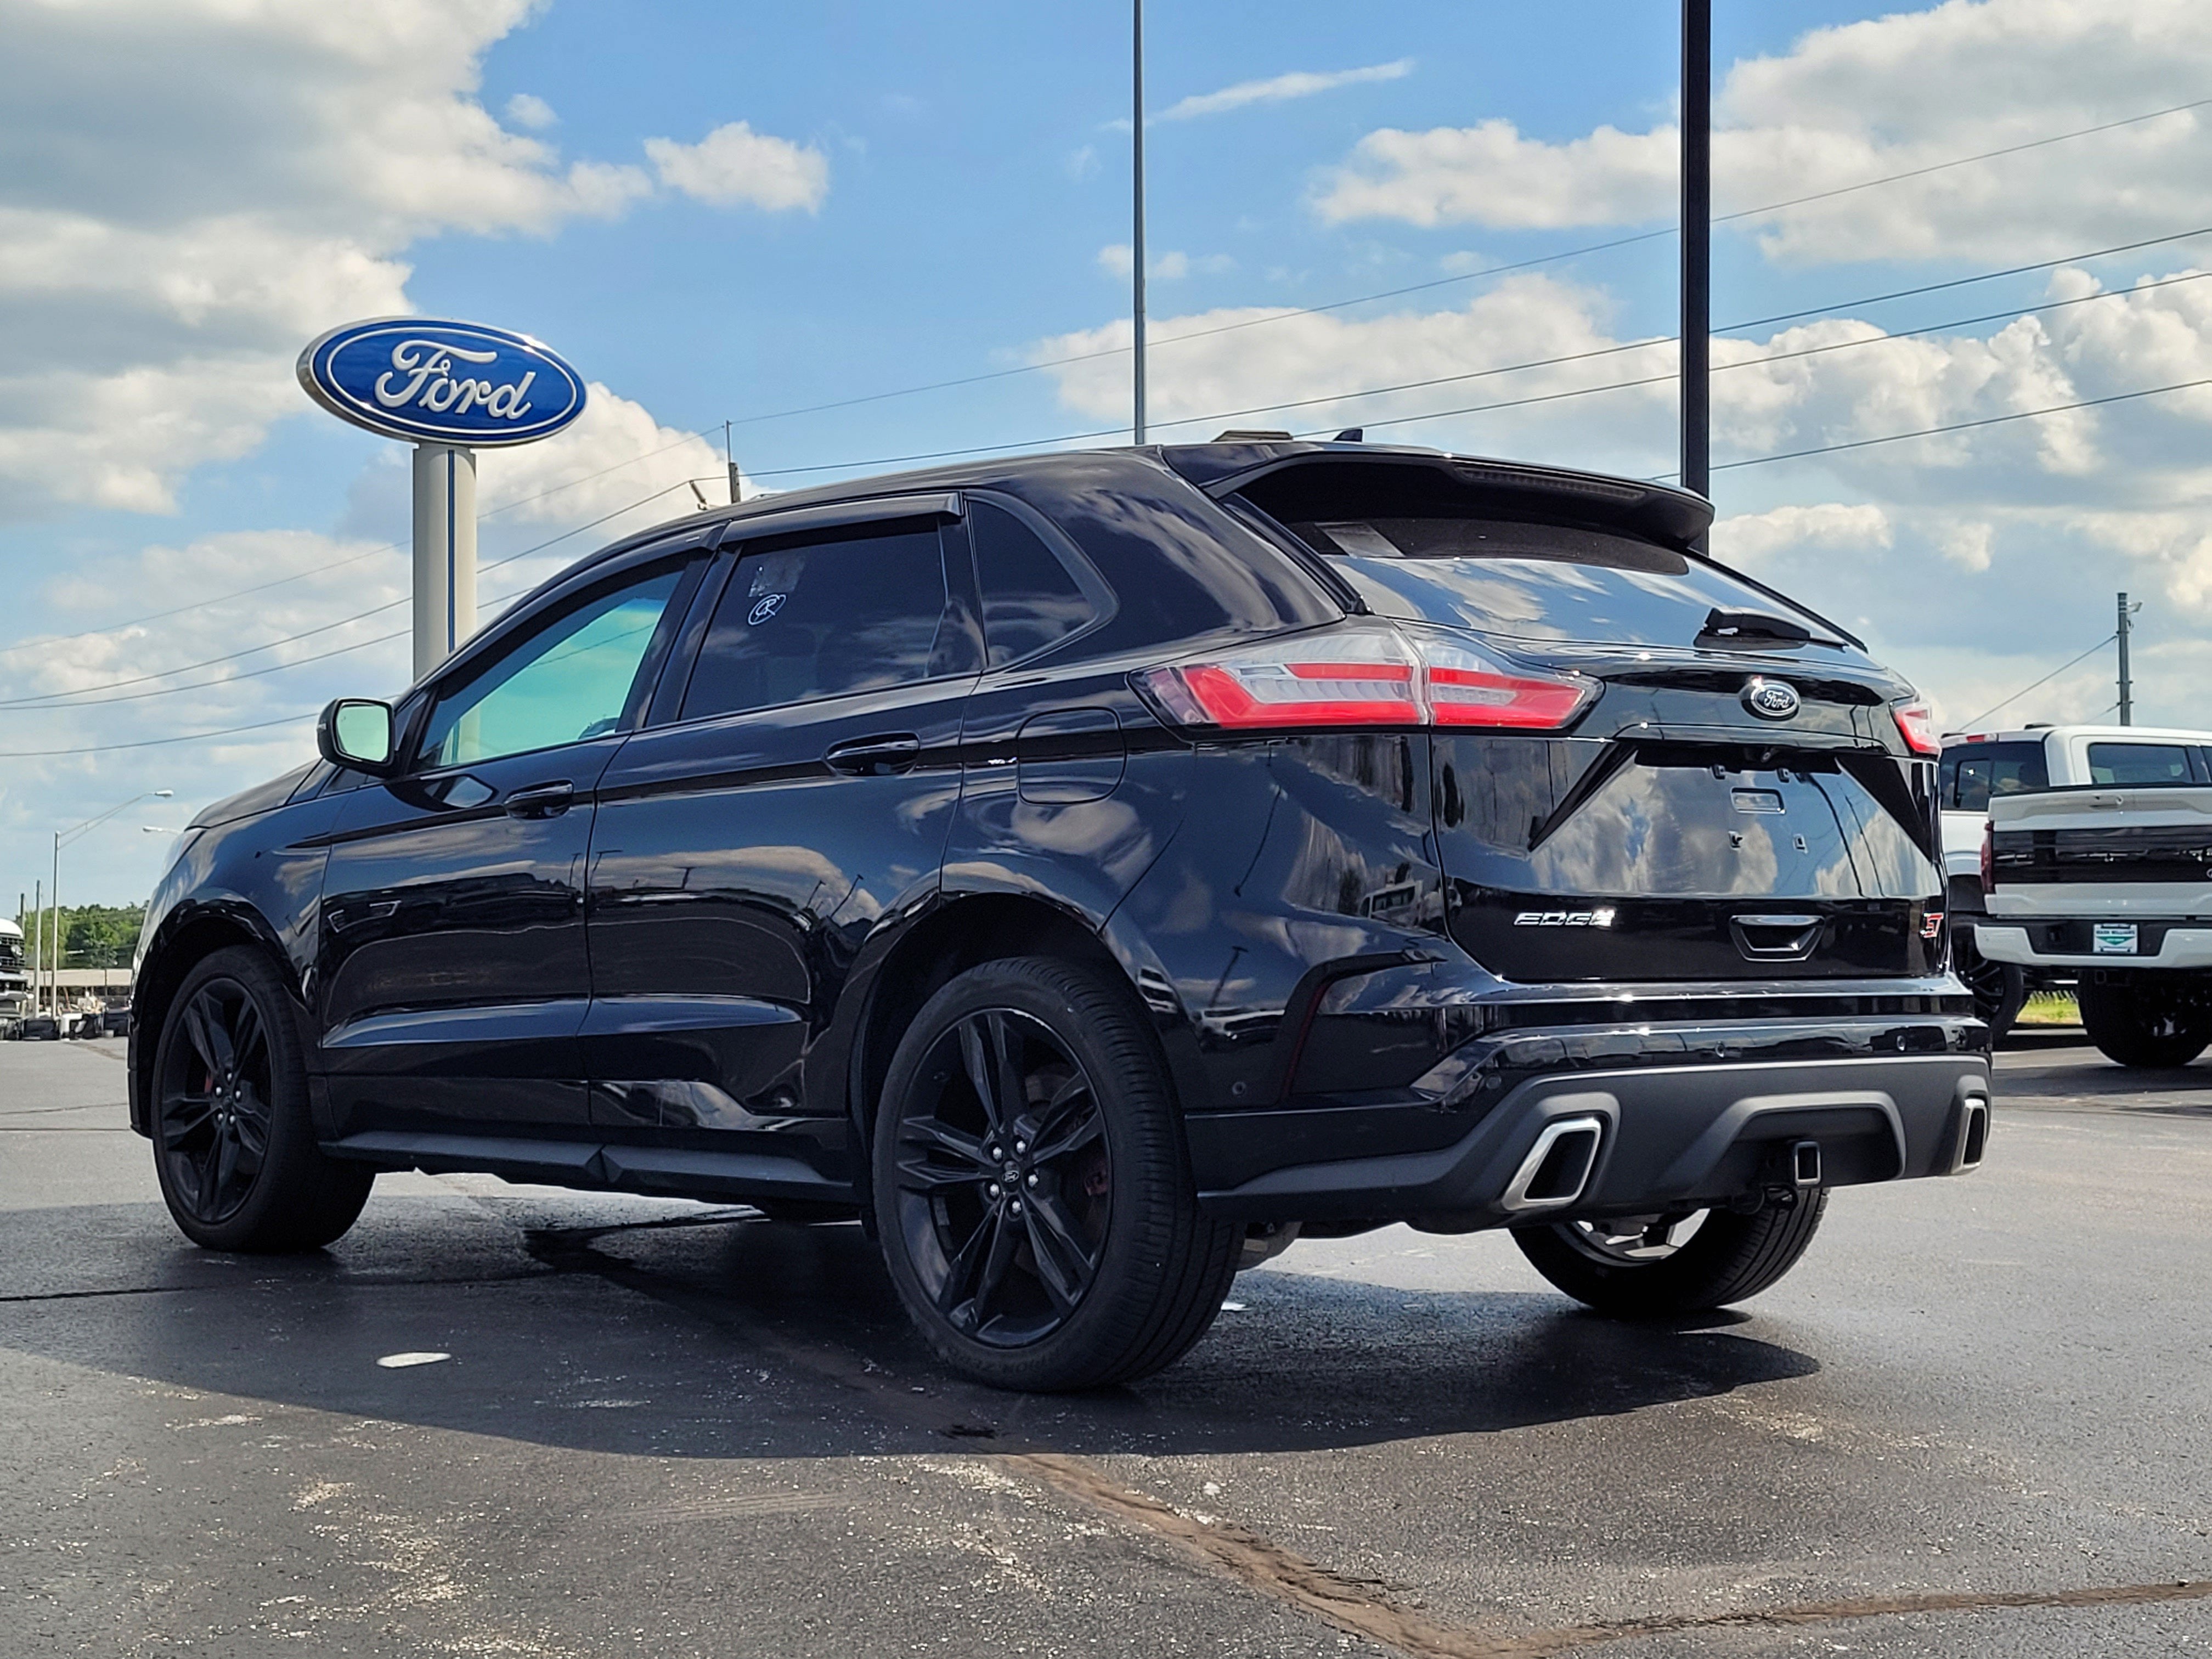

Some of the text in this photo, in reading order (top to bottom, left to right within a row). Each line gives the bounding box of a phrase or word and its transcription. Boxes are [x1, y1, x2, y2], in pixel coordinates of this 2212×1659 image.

[375, 340, 536, 419] Ford
[1764, 690, 1790, 708] Ford
[1514, 909, 1616, 927] EDGE
[1920, 912, 1944, 938] ST
